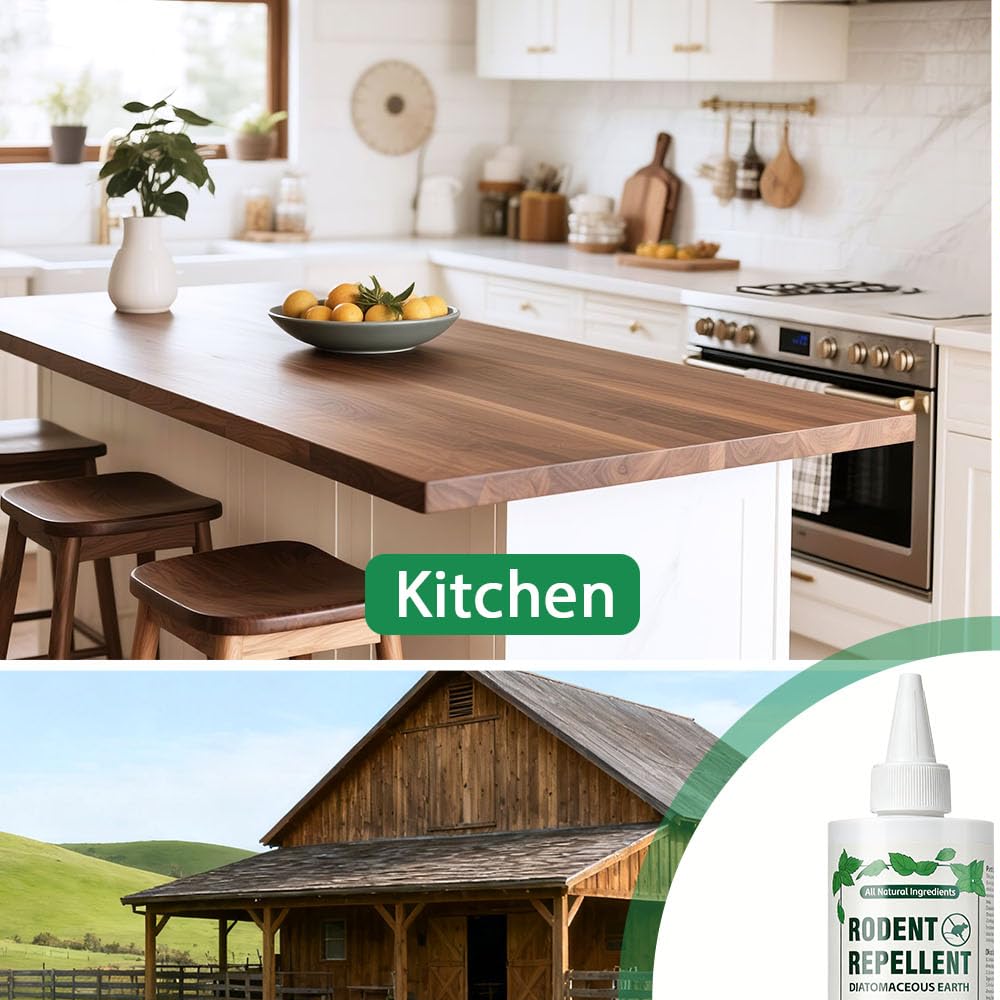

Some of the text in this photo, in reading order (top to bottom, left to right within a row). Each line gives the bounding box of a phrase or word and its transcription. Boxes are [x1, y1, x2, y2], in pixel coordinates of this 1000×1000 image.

[865, 887, 956, 898] All Natural Ingredients
[849, 917, 938, 941] RODENT
[849, 951, 971, 975] REPELLENT
[850, 982, 970, 993] DIATOMACEOUS EARTH
